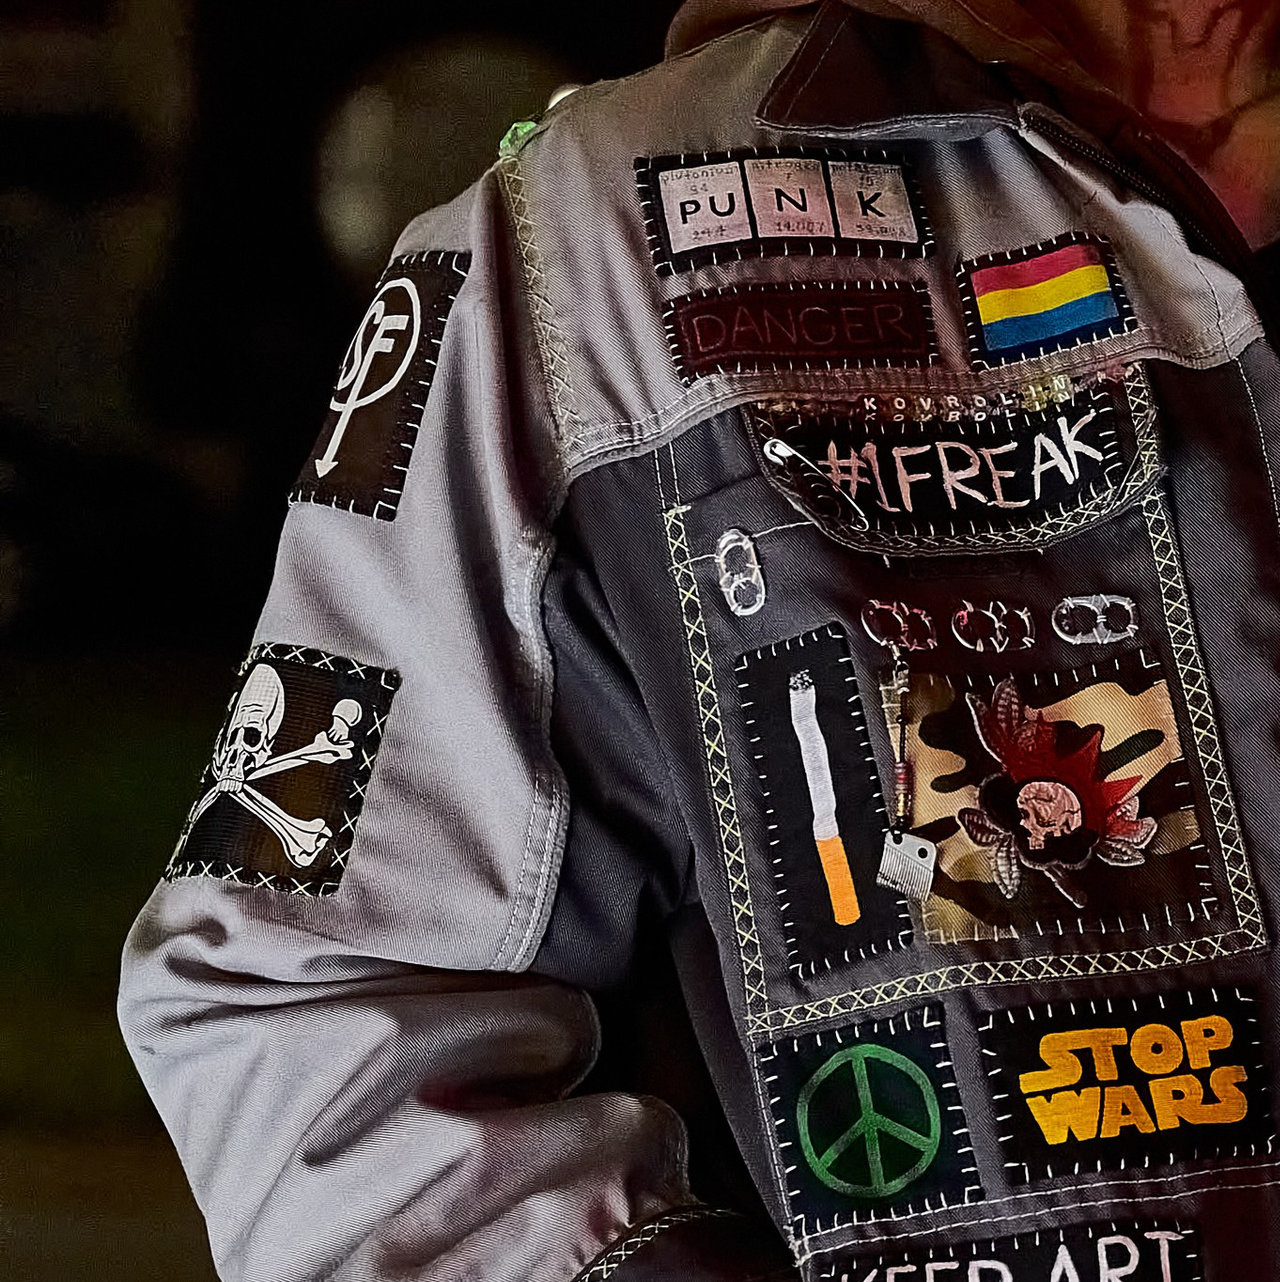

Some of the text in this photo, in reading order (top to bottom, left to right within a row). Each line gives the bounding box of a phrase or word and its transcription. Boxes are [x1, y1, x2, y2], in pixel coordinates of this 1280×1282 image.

[692, 302, 913, 352] DANGER
[1018, 1014, 1234, 1094] STOP
[1025, 1065, 1249, 1146] WARS
